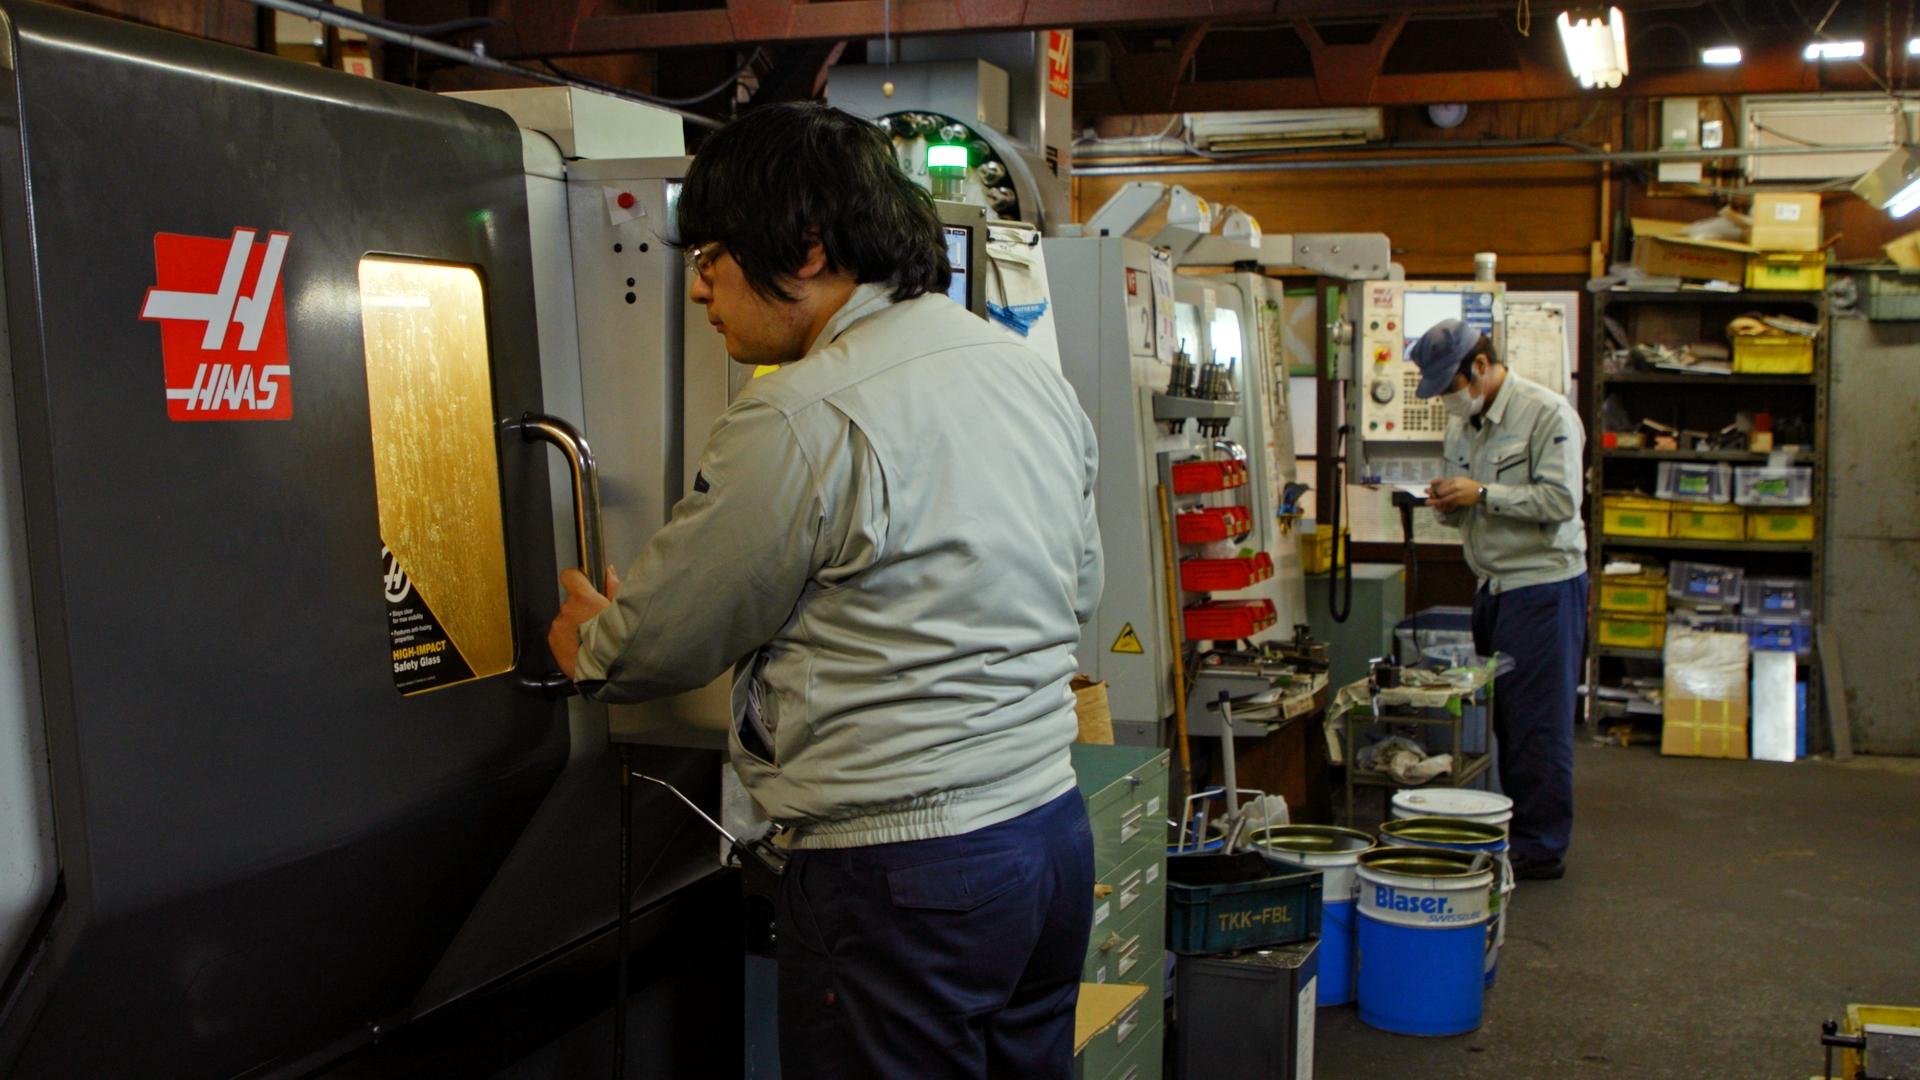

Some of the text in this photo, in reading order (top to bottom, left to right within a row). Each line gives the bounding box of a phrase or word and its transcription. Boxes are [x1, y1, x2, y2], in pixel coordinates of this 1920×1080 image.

[165, 363, 291, 411] HAAS
[393, 640, 446, 660] HIGH-IMPACT
[393, 655, 441, 673] Safety Glass
[1218, 905, 1292, 932] TKK-FBL
